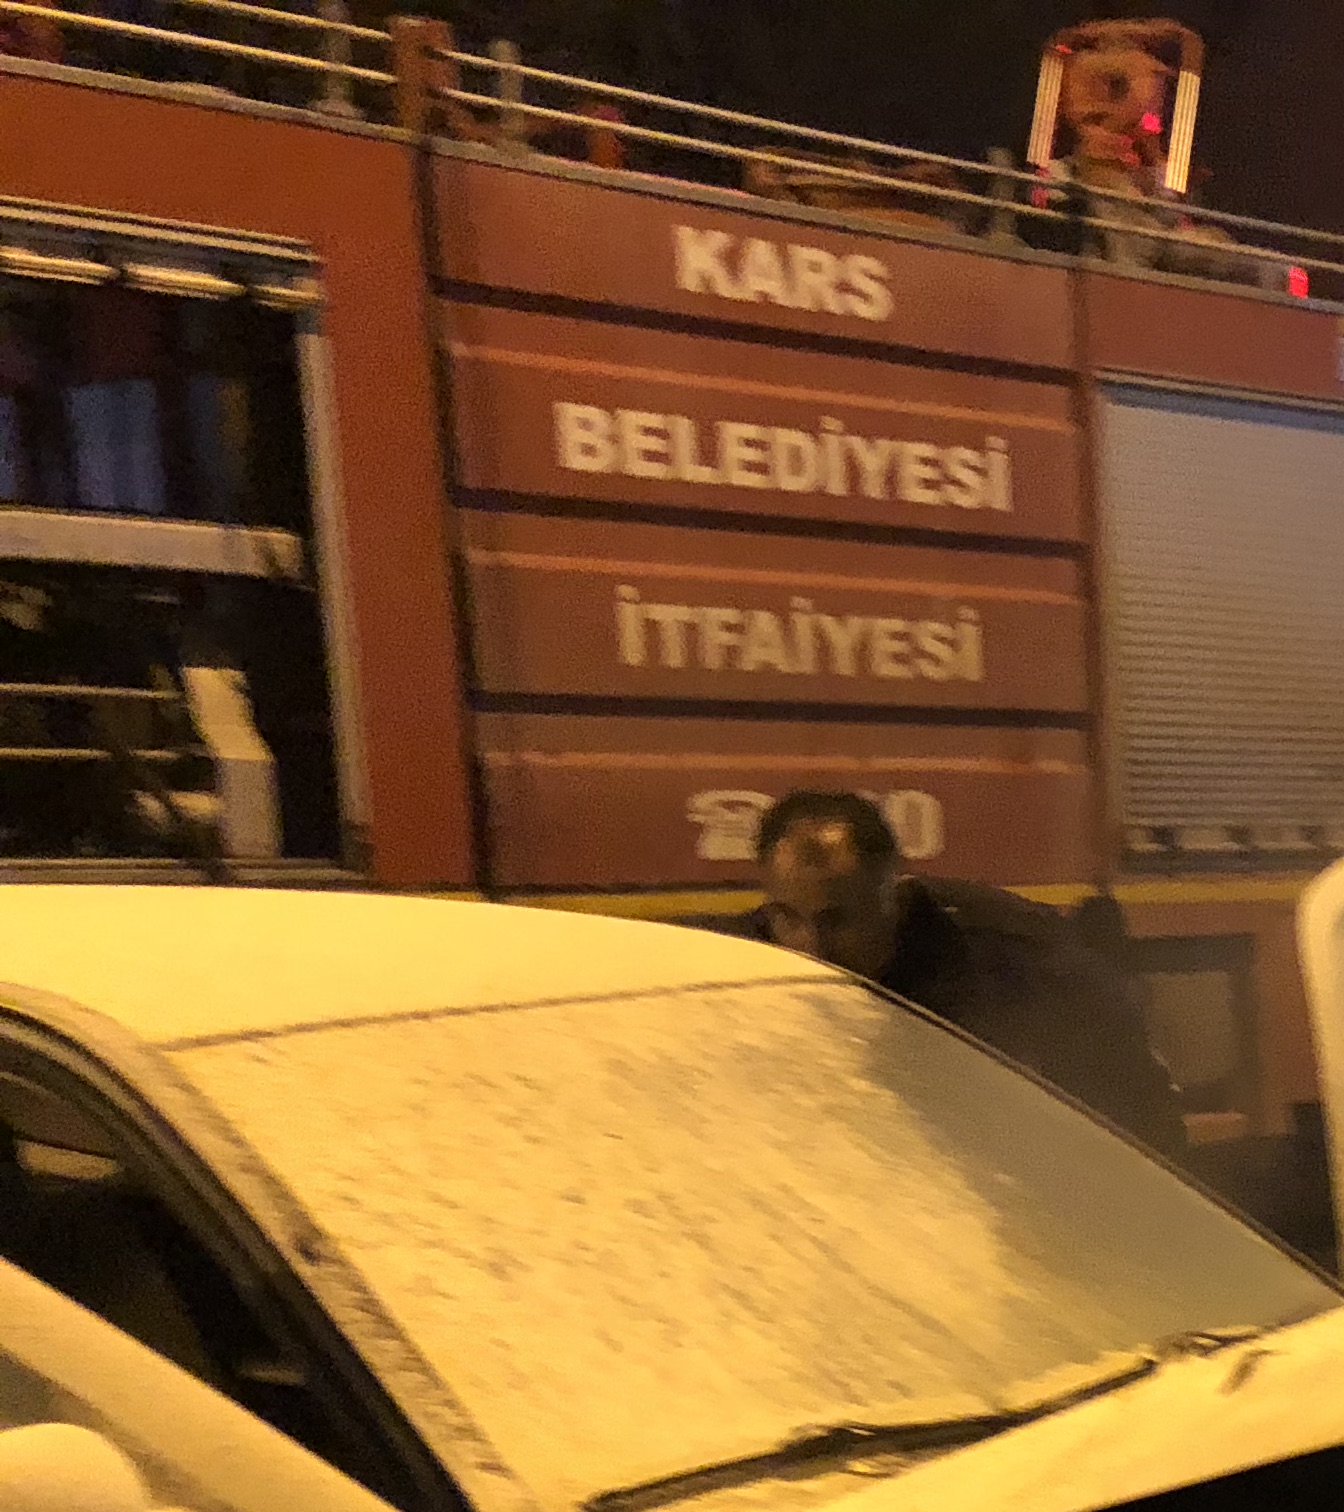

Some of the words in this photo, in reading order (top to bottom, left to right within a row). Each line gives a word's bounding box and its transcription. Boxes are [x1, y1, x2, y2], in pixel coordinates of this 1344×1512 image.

[673, 224, 895, 322] KARS
[552, 401, 1012, 513] BELEDİYESİ
[614, 585, 986, 683] İTFAİYESİ
